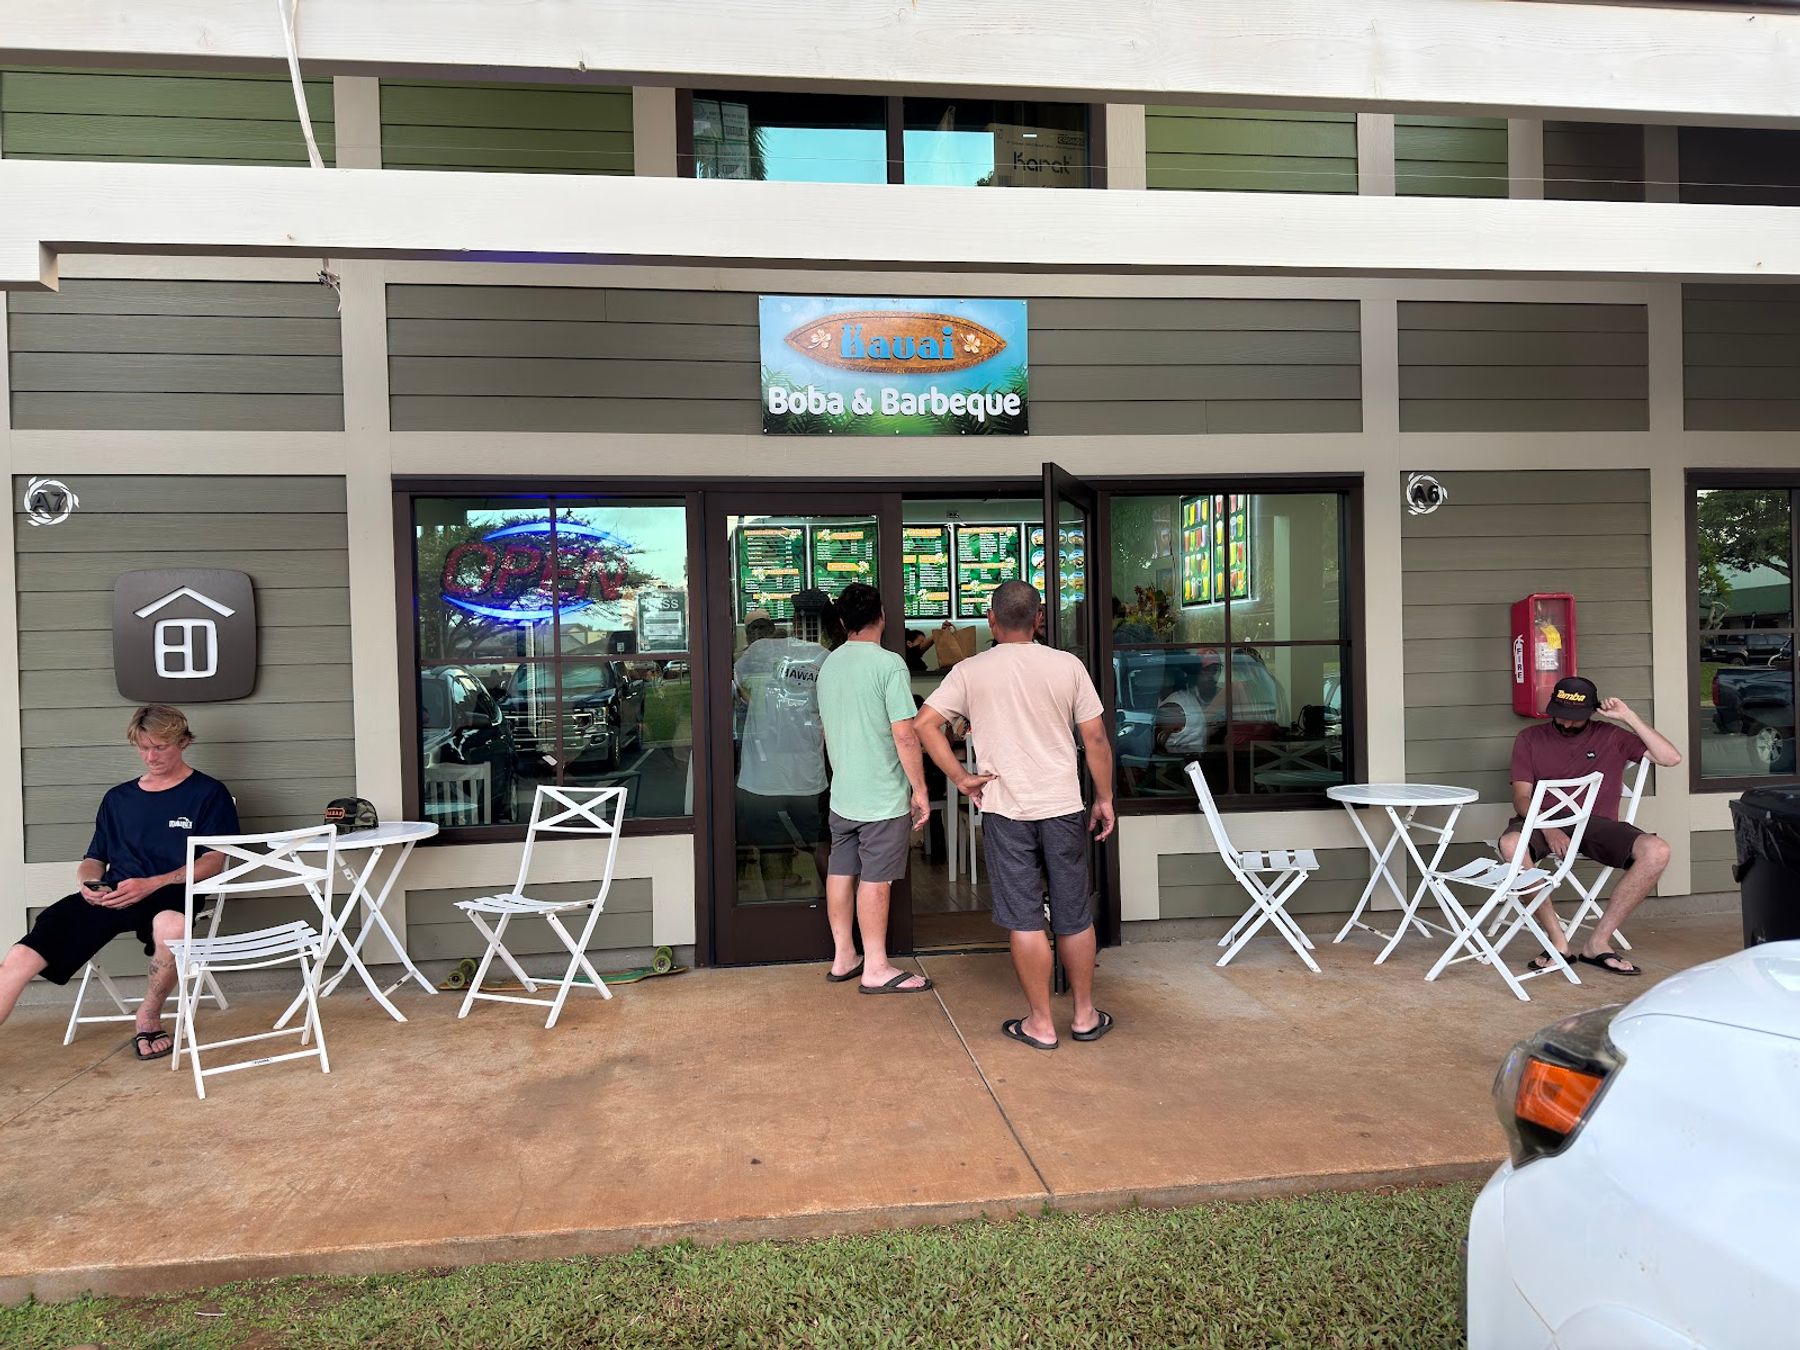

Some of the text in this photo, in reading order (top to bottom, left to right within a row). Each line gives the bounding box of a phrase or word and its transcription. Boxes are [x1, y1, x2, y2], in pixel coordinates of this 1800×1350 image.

[1013, 151, 1070, 175] Karat
[839, 323, 955, 360] Kauai
[767, 386, 1021, 423] Boba & Barbeque
[29, 491, 68, 512] A7
[1411, 484, 1440, 504] A6
[442, 542, 630, 601] OPEN
[1516, 647, 1524, 680] FIRE
